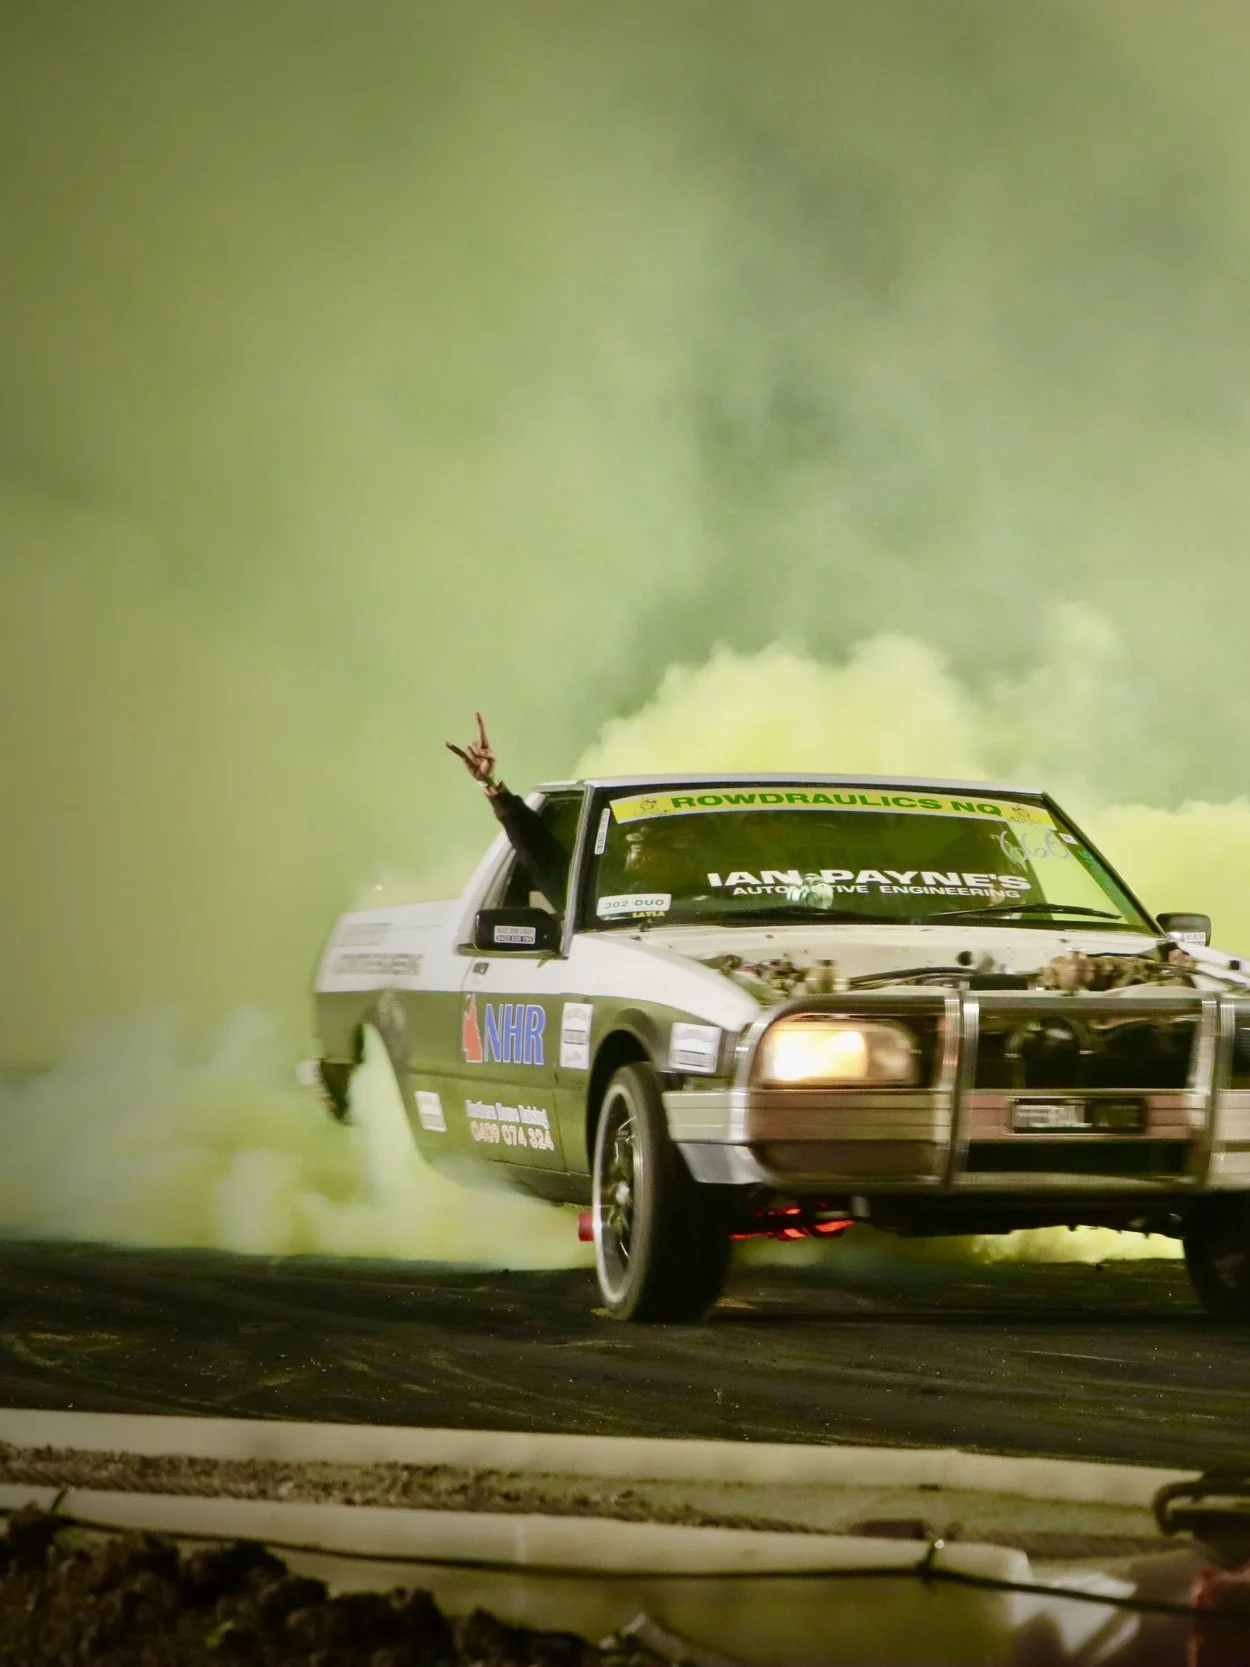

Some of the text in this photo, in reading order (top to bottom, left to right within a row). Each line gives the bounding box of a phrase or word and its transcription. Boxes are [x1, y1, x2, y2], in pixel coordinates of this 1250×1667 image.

[671, 793, 1002, 817] ROWDRAULICS NQ
[707, 869, 1032, 890] IAN PAYNE'S
[880, 885, 1021, 898] ENGINEERING
[484, 1003, 546, 1066] NHR
